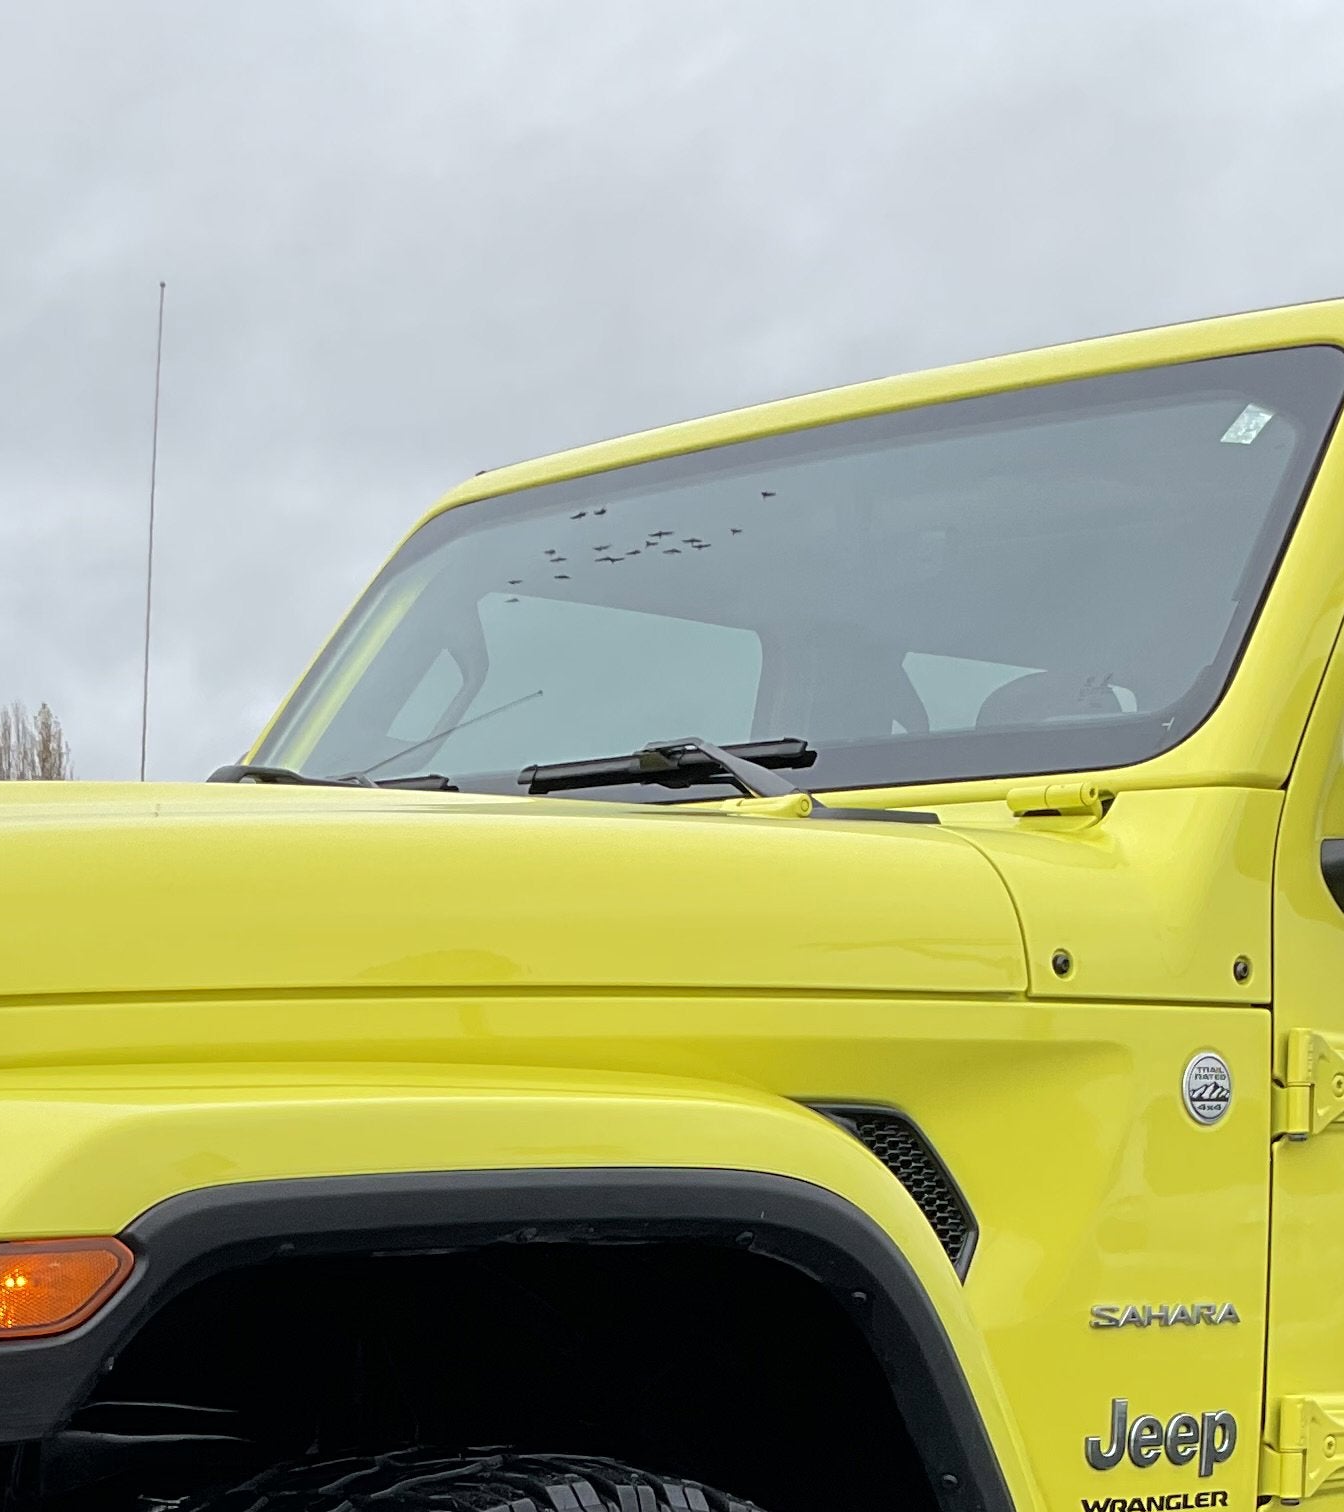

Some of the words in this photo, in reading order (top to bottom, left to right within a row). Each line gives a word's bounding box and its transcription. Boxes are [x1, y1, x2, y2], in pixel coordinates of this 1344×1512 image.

[1194, 1073, 1227, 1081] RATED
[1196, 1066, 1225, 1074] TRAIL
[1089, 1302, 1241, 1328] SAHARA
[1084, 1397, 1237, 1478] Jeep
